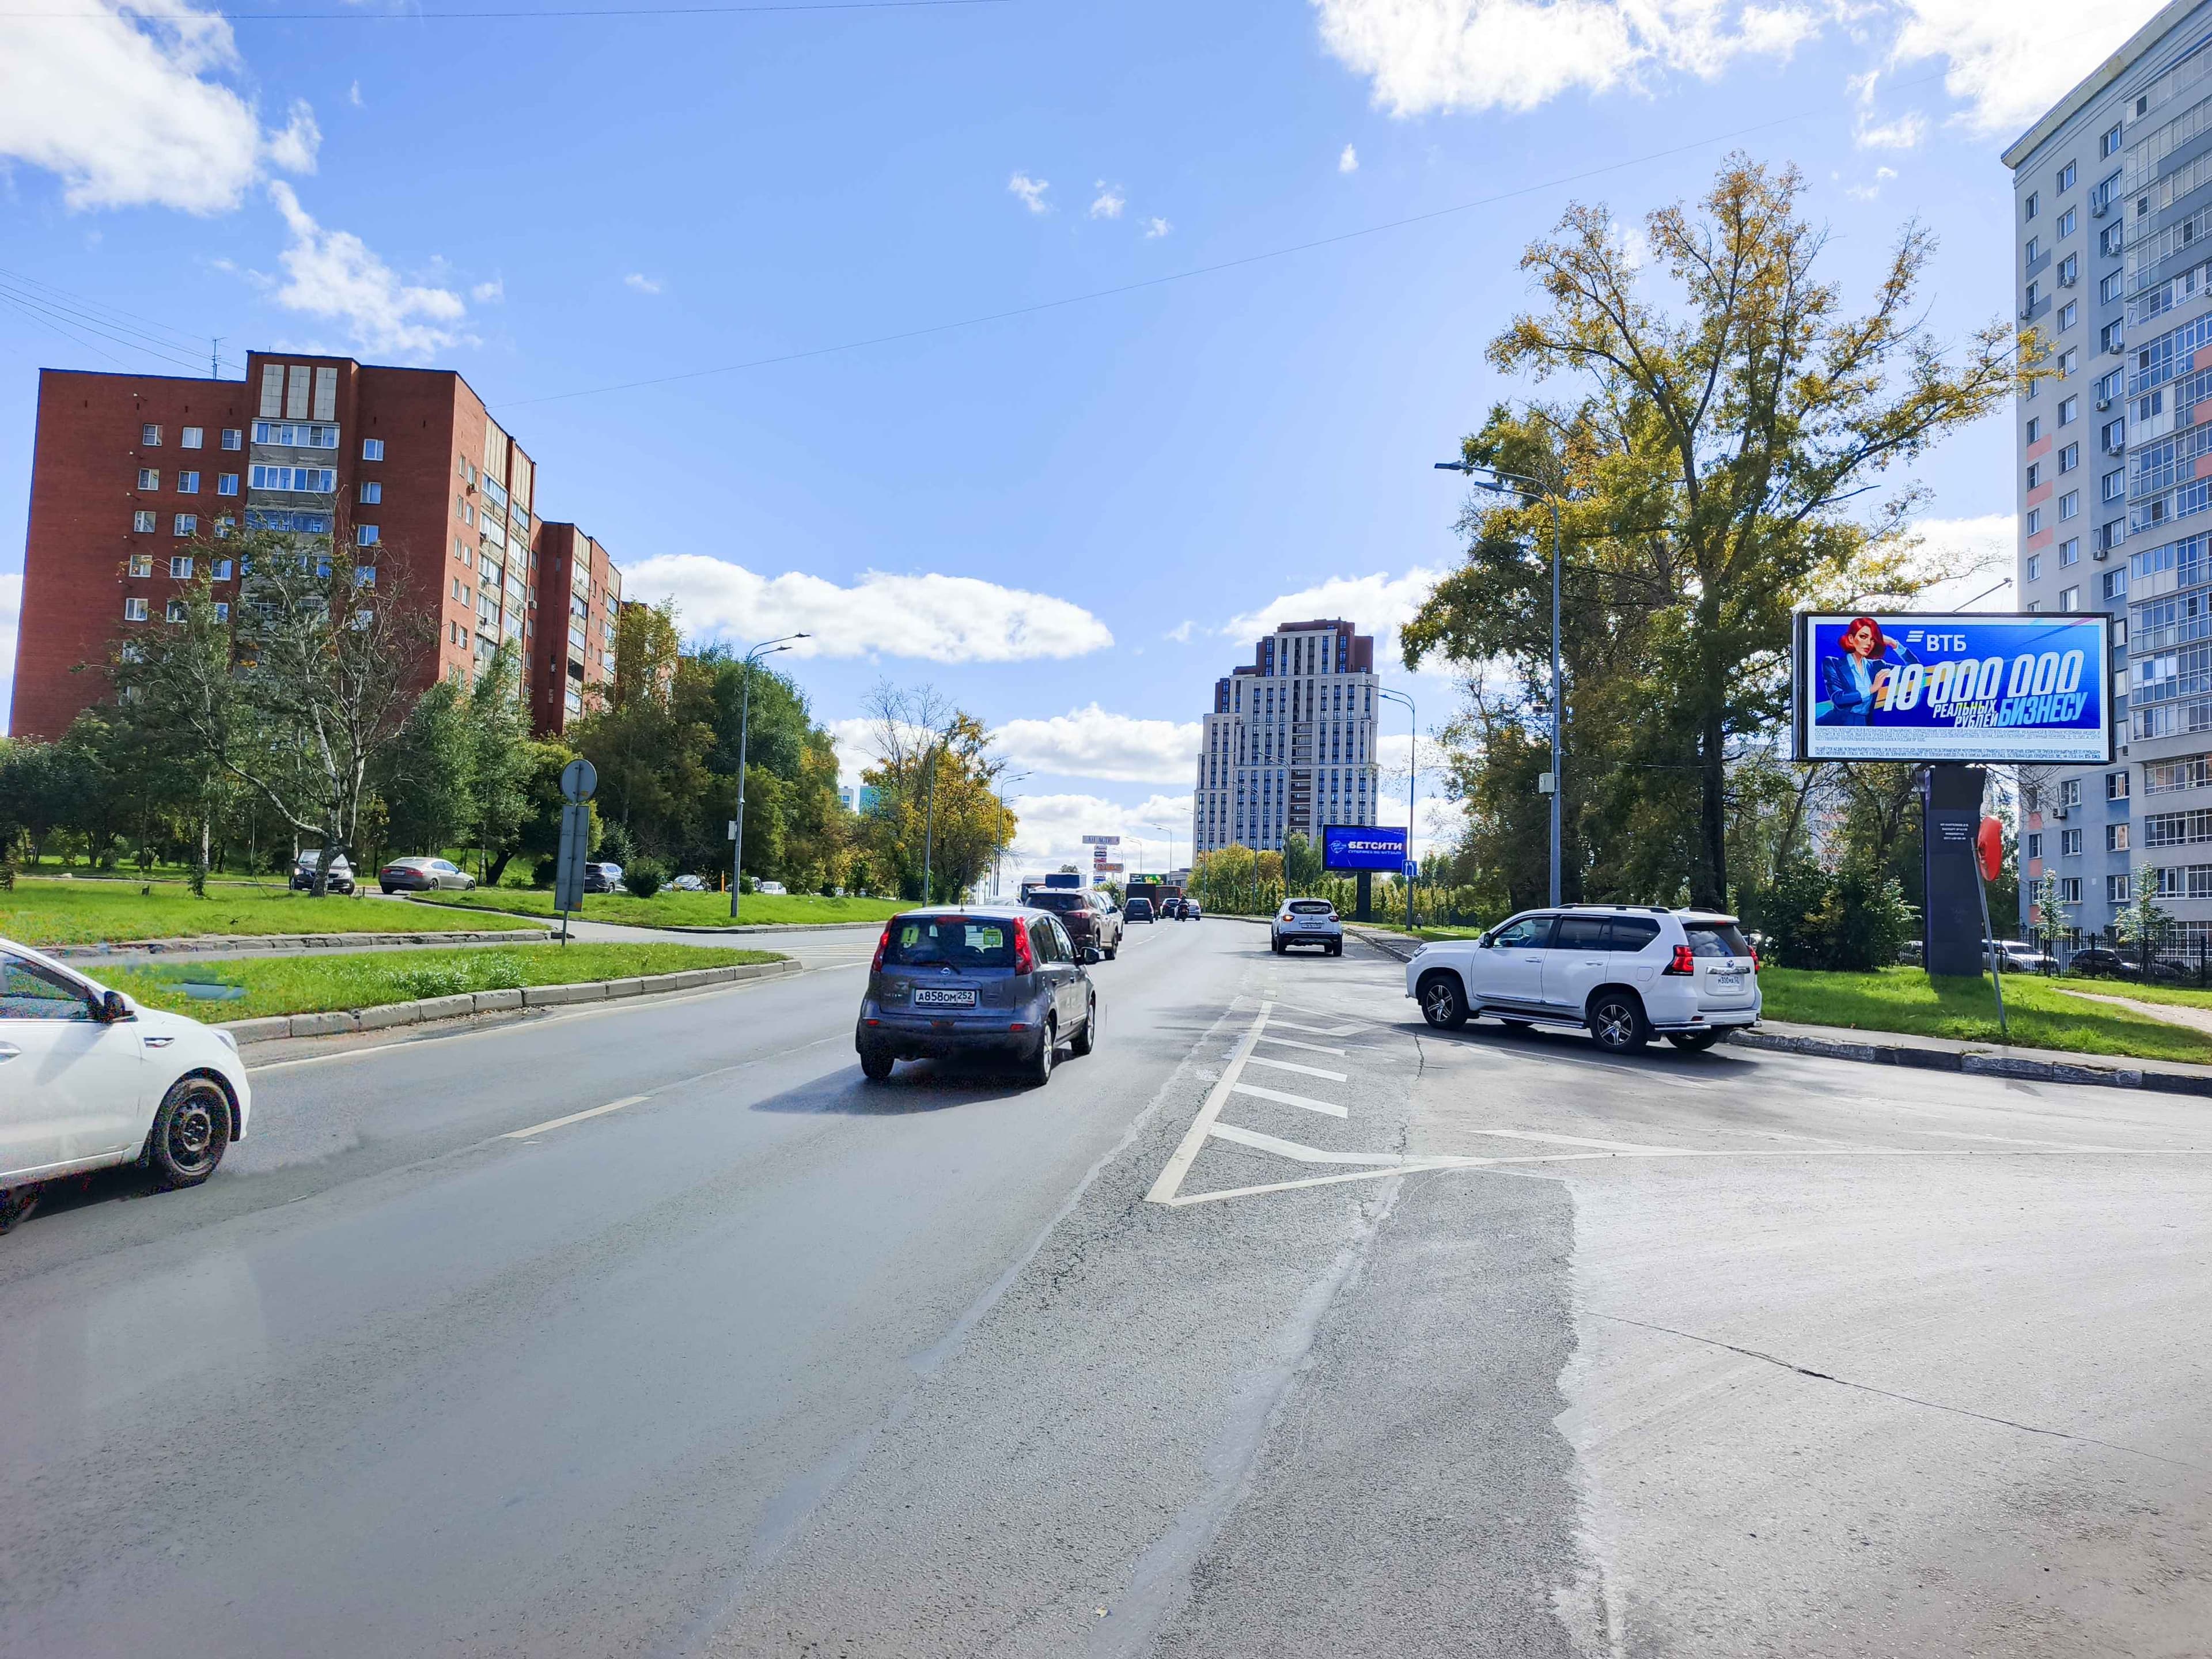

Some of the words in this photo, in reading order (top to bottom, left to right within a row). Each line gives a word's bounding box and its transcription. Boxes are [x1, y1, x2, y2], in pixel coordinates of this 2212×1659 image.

[1926, 634, 1967, 652] ВТБ
[1883, 664, 1924, 711] 10
[1927, 657, 2003, 707] 000
[2008, 649, 2085, 698] 000
[1933, 699, 1997, 718] РЕАЛЬНЫХ
[1997, 692, 2089, 727] БИЗНЕСУ
[1953, 711, 1999, 728] РУБЛЕЙ
[1348, 842, 1402, 850] БЕТСИТИ
[918, 991, 956, 1002] А858ОМ
